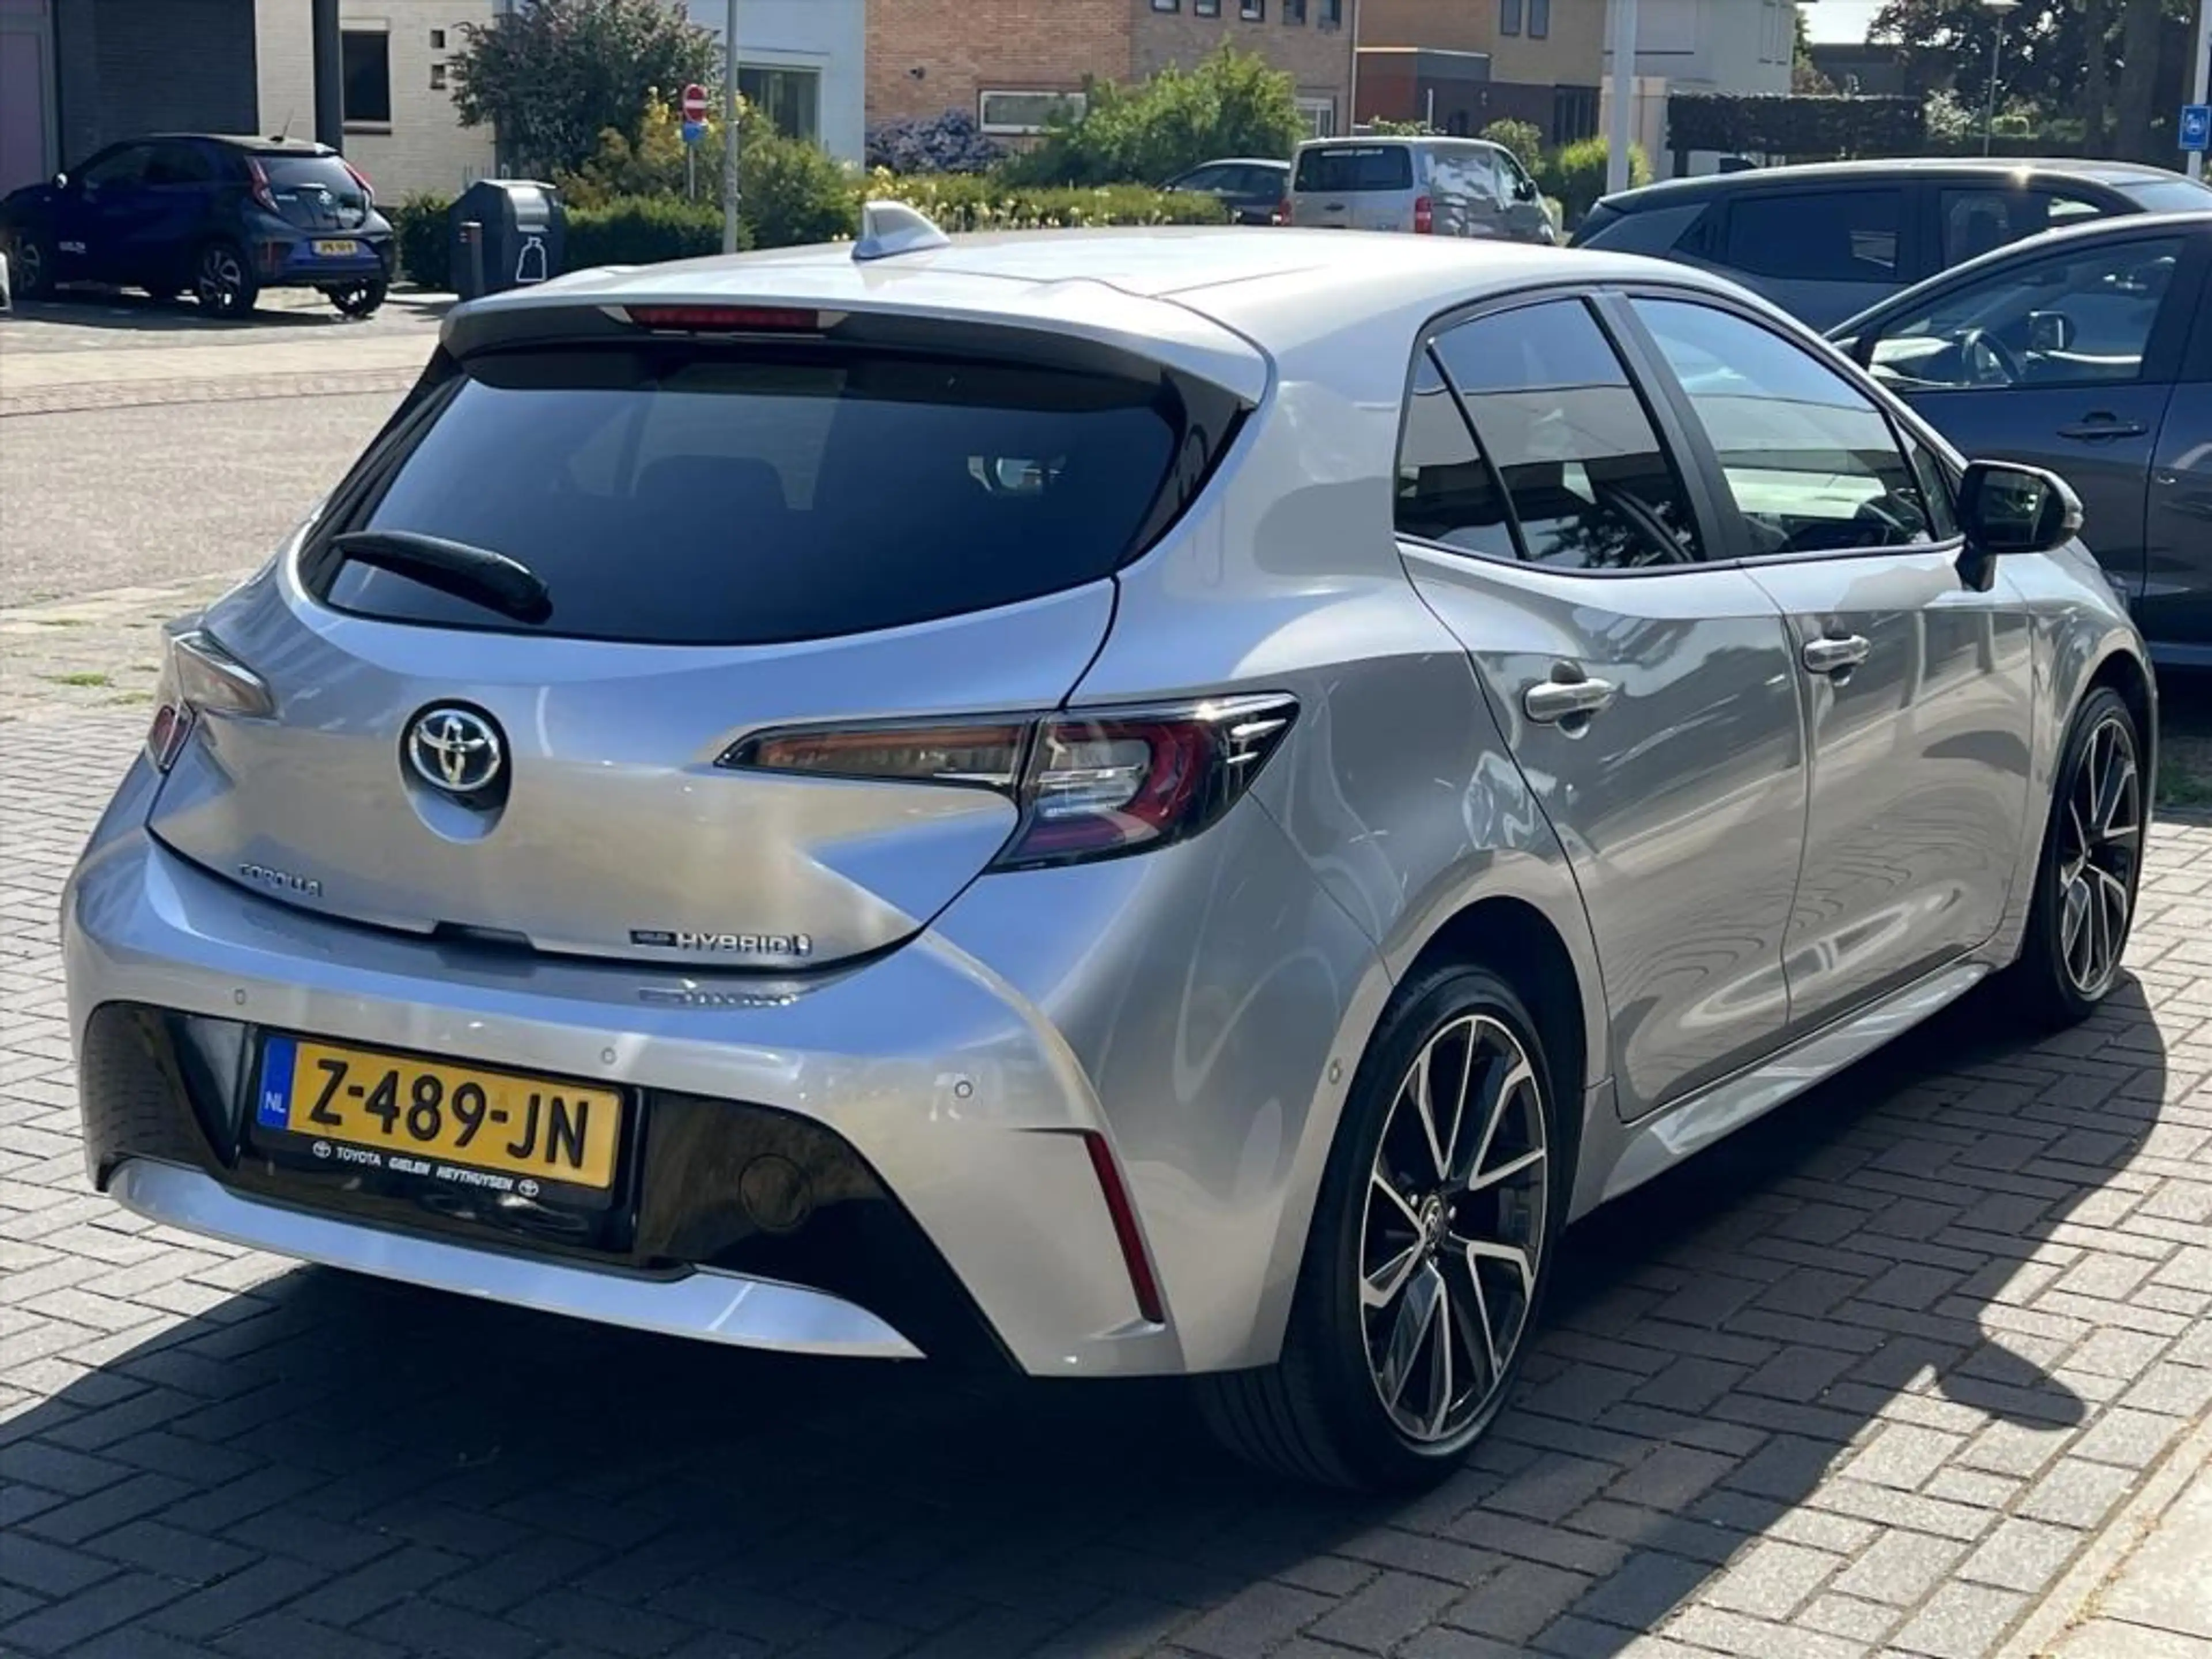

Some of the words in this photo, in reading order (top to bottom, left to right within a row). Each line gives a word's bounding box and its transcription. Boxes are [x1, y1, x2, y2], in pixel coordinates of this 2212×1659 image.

[238, 862, 323, 897] COROLLA
[677, 932, 792, 955] HYBRID
[264, 1090, 286, 1114] NL
[308, 1058, 589, 1169] Z-489-JN
[336, 1146, 381, 1167] TOYOTA
